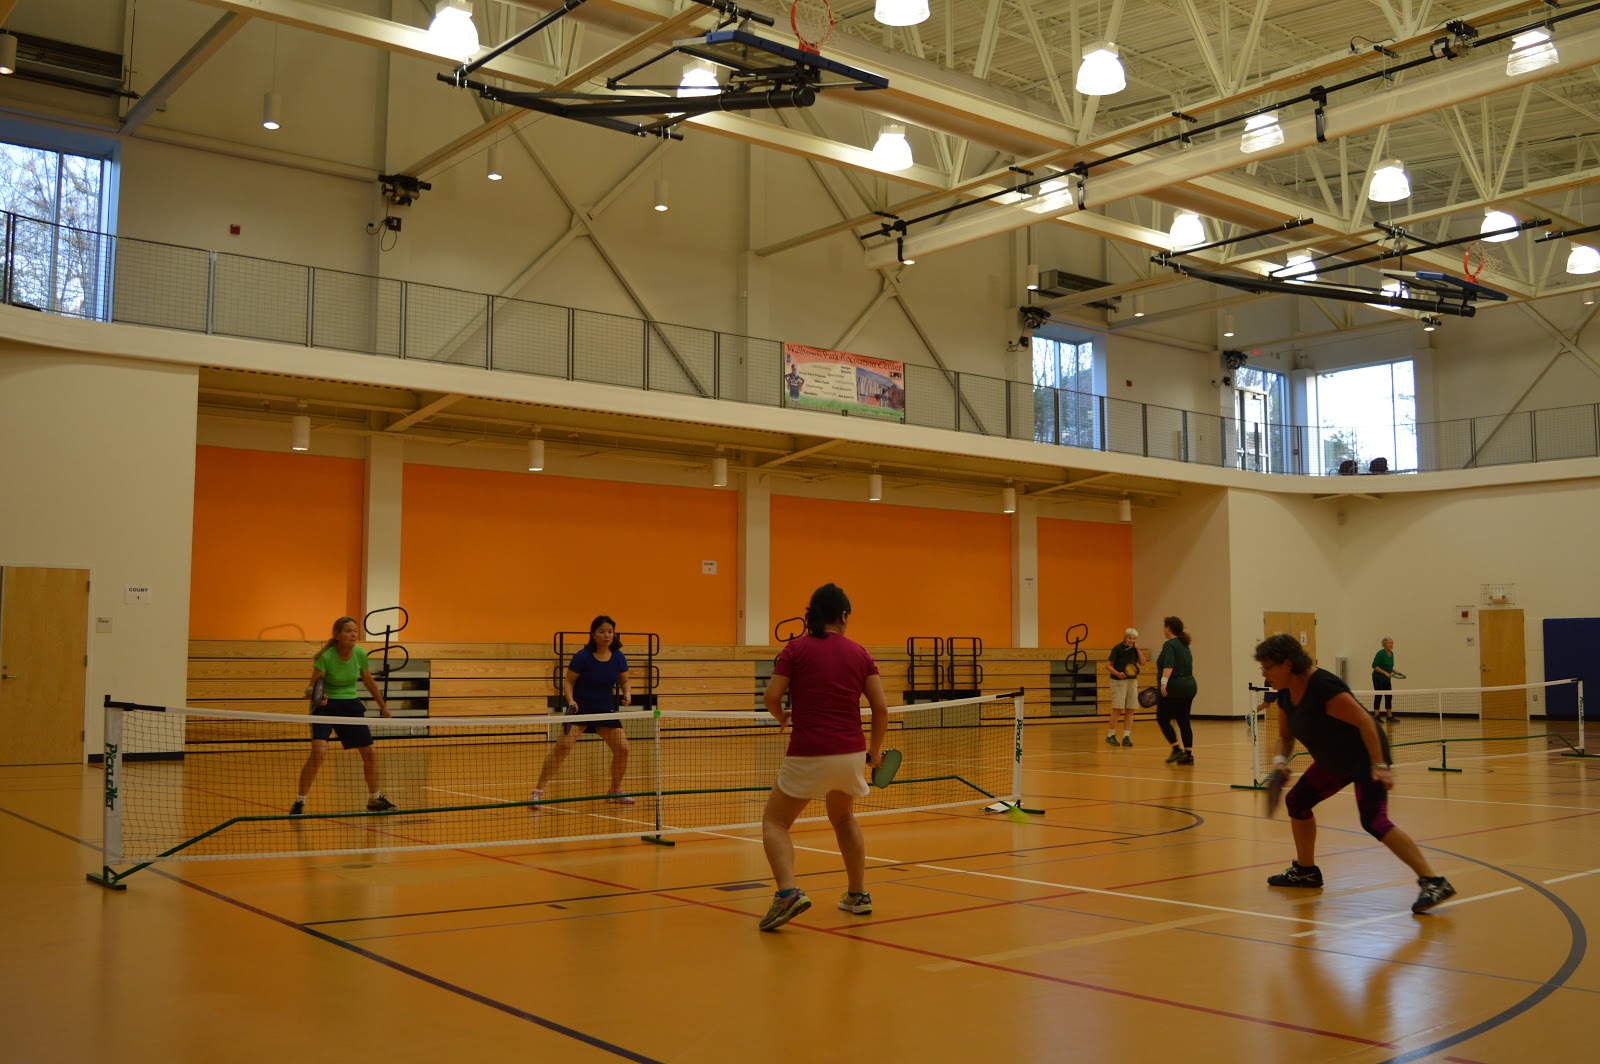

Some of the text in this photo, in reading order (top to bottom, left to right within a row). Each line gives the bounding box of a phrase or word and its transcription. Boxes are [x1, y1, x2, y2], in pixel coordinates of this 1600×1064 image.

[822, 350, 839, 361] Park
[840, 354, 876, 368] Recreation
[878, 361, 902, 371] Center
